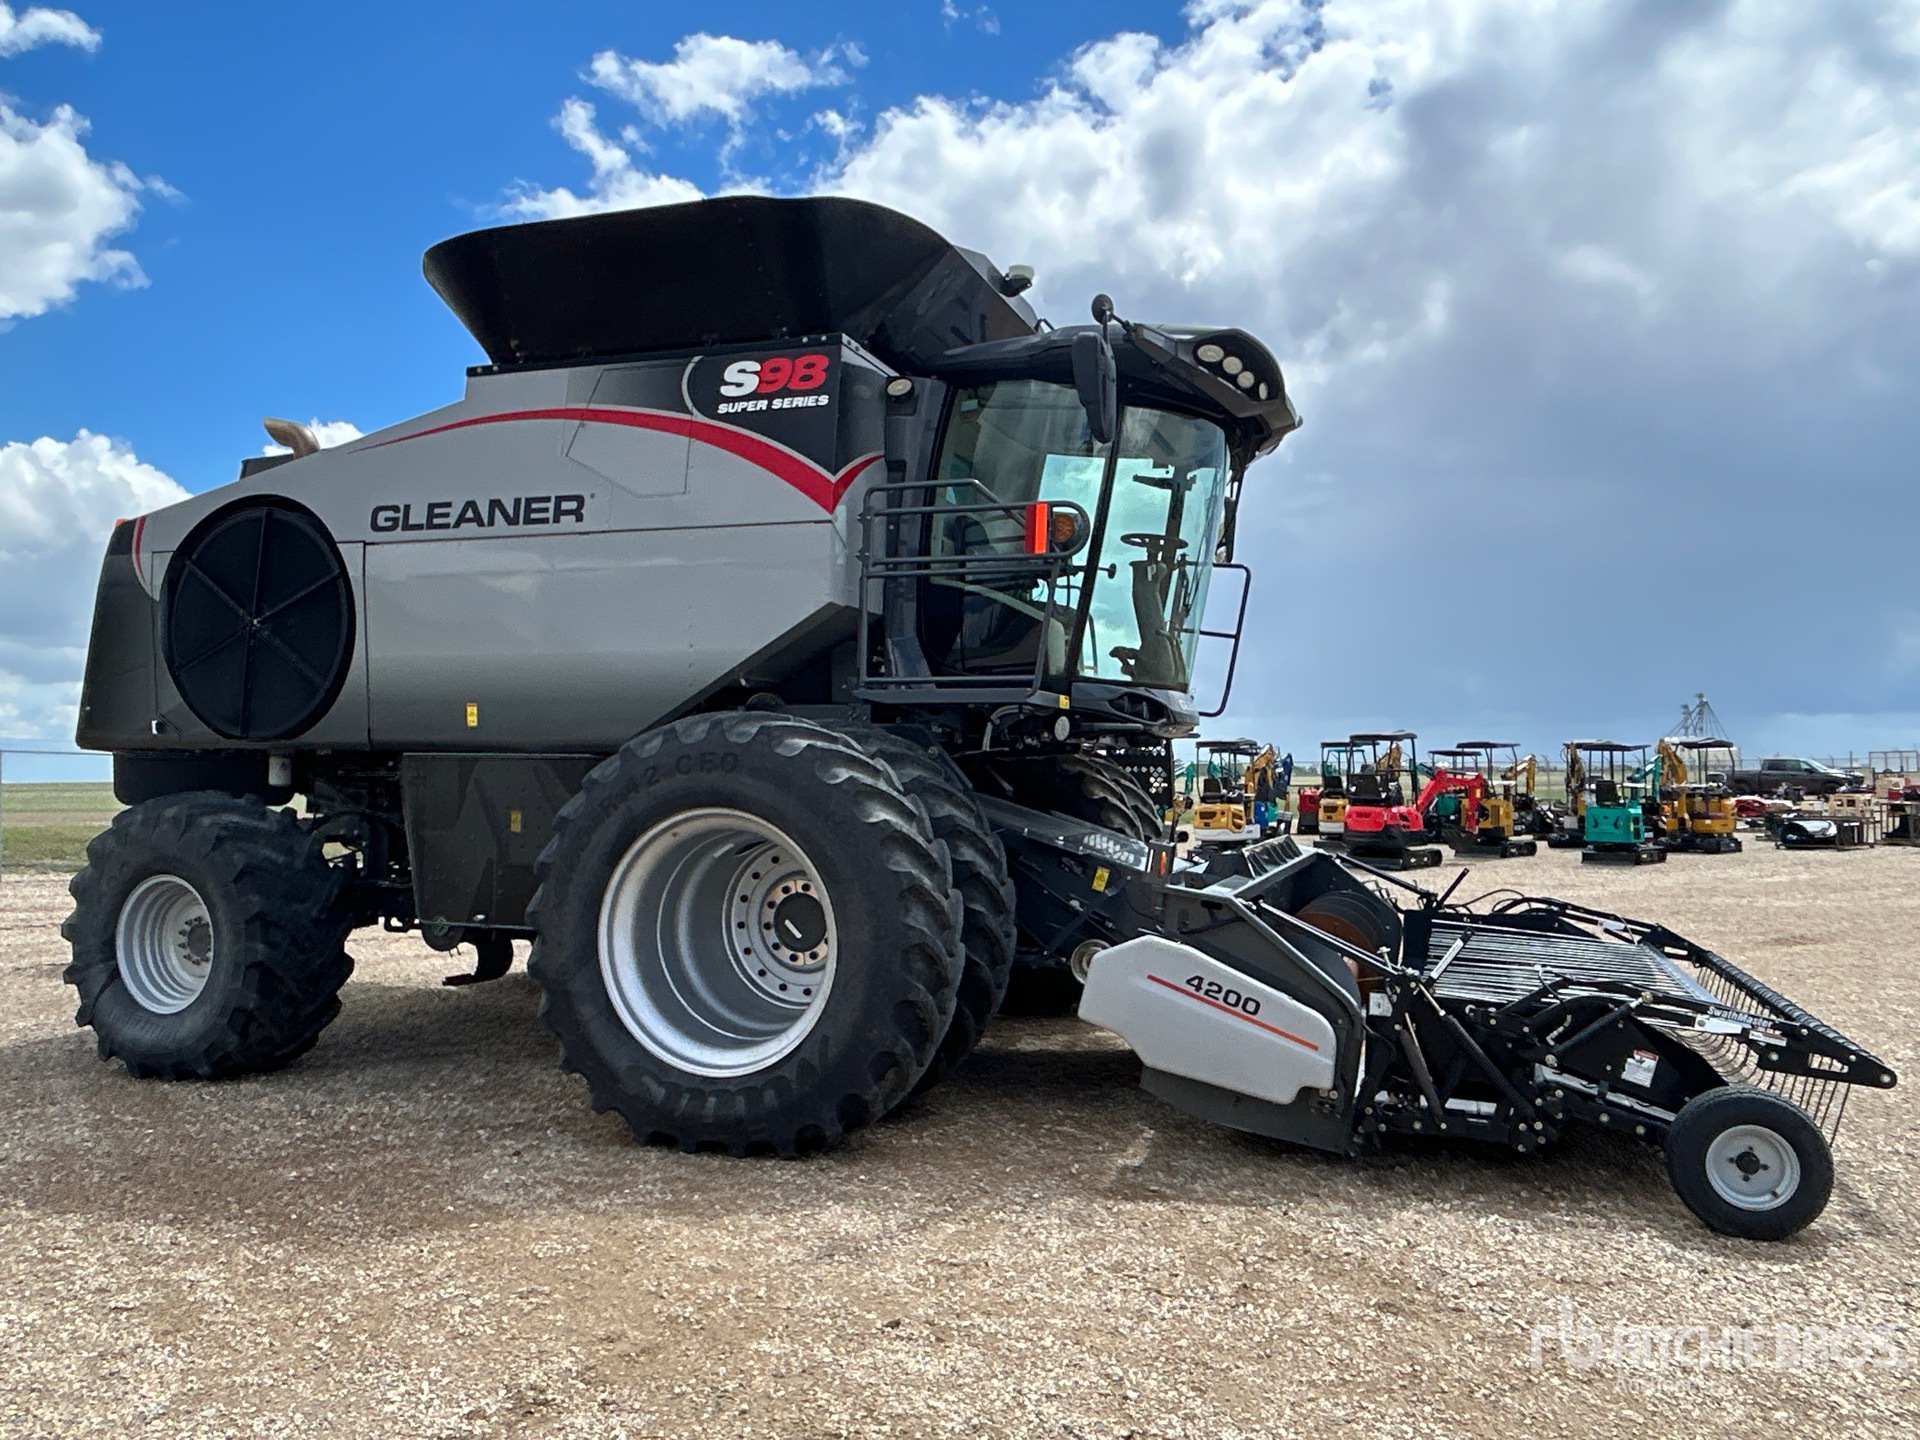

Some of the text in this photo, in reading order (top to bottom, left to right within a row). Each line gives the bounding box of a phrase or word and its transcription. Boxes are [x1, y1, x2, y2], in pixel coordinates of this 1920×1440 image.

[720, 354, 829, 397] S98
[717, 395, 829, 414] SUPER SERIES
[369, 494, 586, 532] GLEANER
[1185, 975, 1261, 1016] 4200
